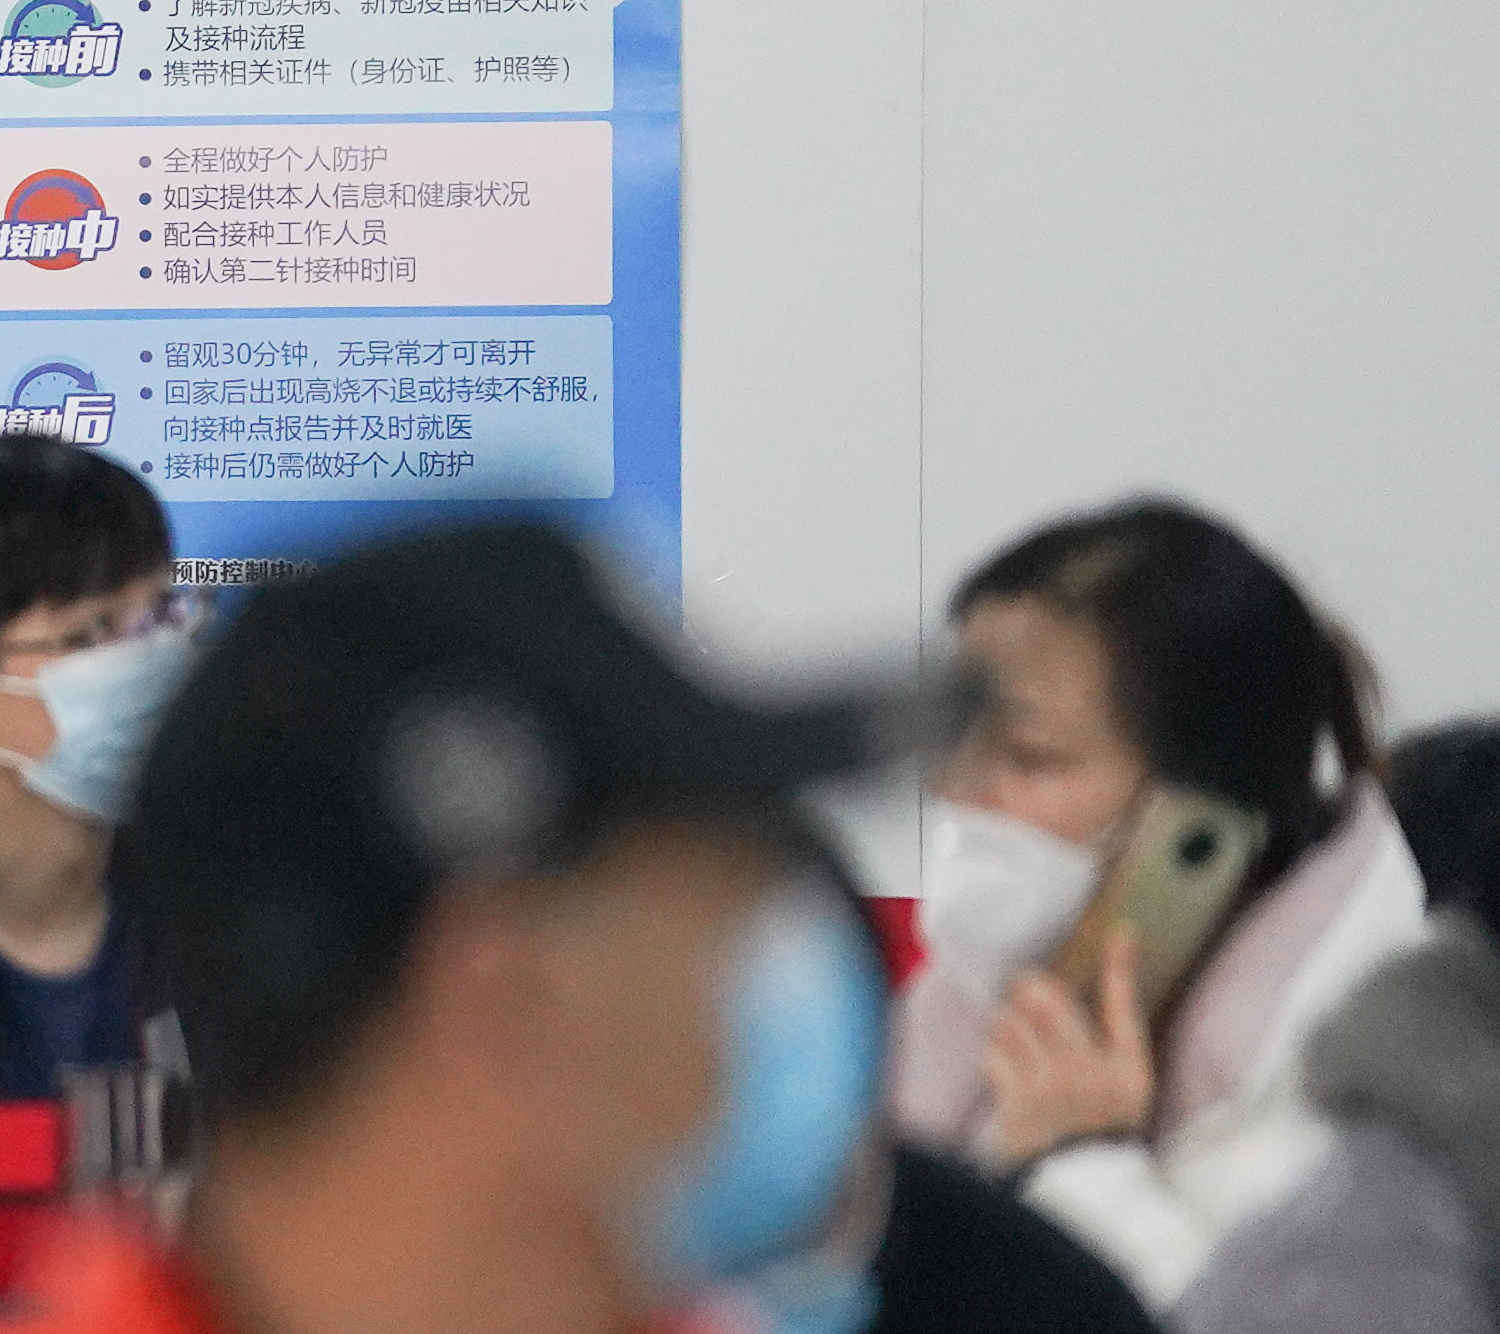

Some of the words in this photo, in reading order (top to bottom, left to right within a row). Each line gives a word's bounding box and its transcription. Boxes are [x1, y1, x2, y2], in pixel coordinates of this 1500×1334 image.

[163, 26, 305, 52] 及接种流程
[164, 145, 387, 175] 全程做好个人防护
[163, 182, 530, 210] 如实提供本人信息和健康状况
[164, 220, 387, 248] 配合接种工作人员
[164, 257, 417, 285] 确认第二针接种时间
[164, 339, 536, 370] 留观30分钟，无异常才可离开
[164, 414, 472, 443] 向接种点报告并及时就医
[164, 451, 474, 480] 接种后仍需做好个人防护
